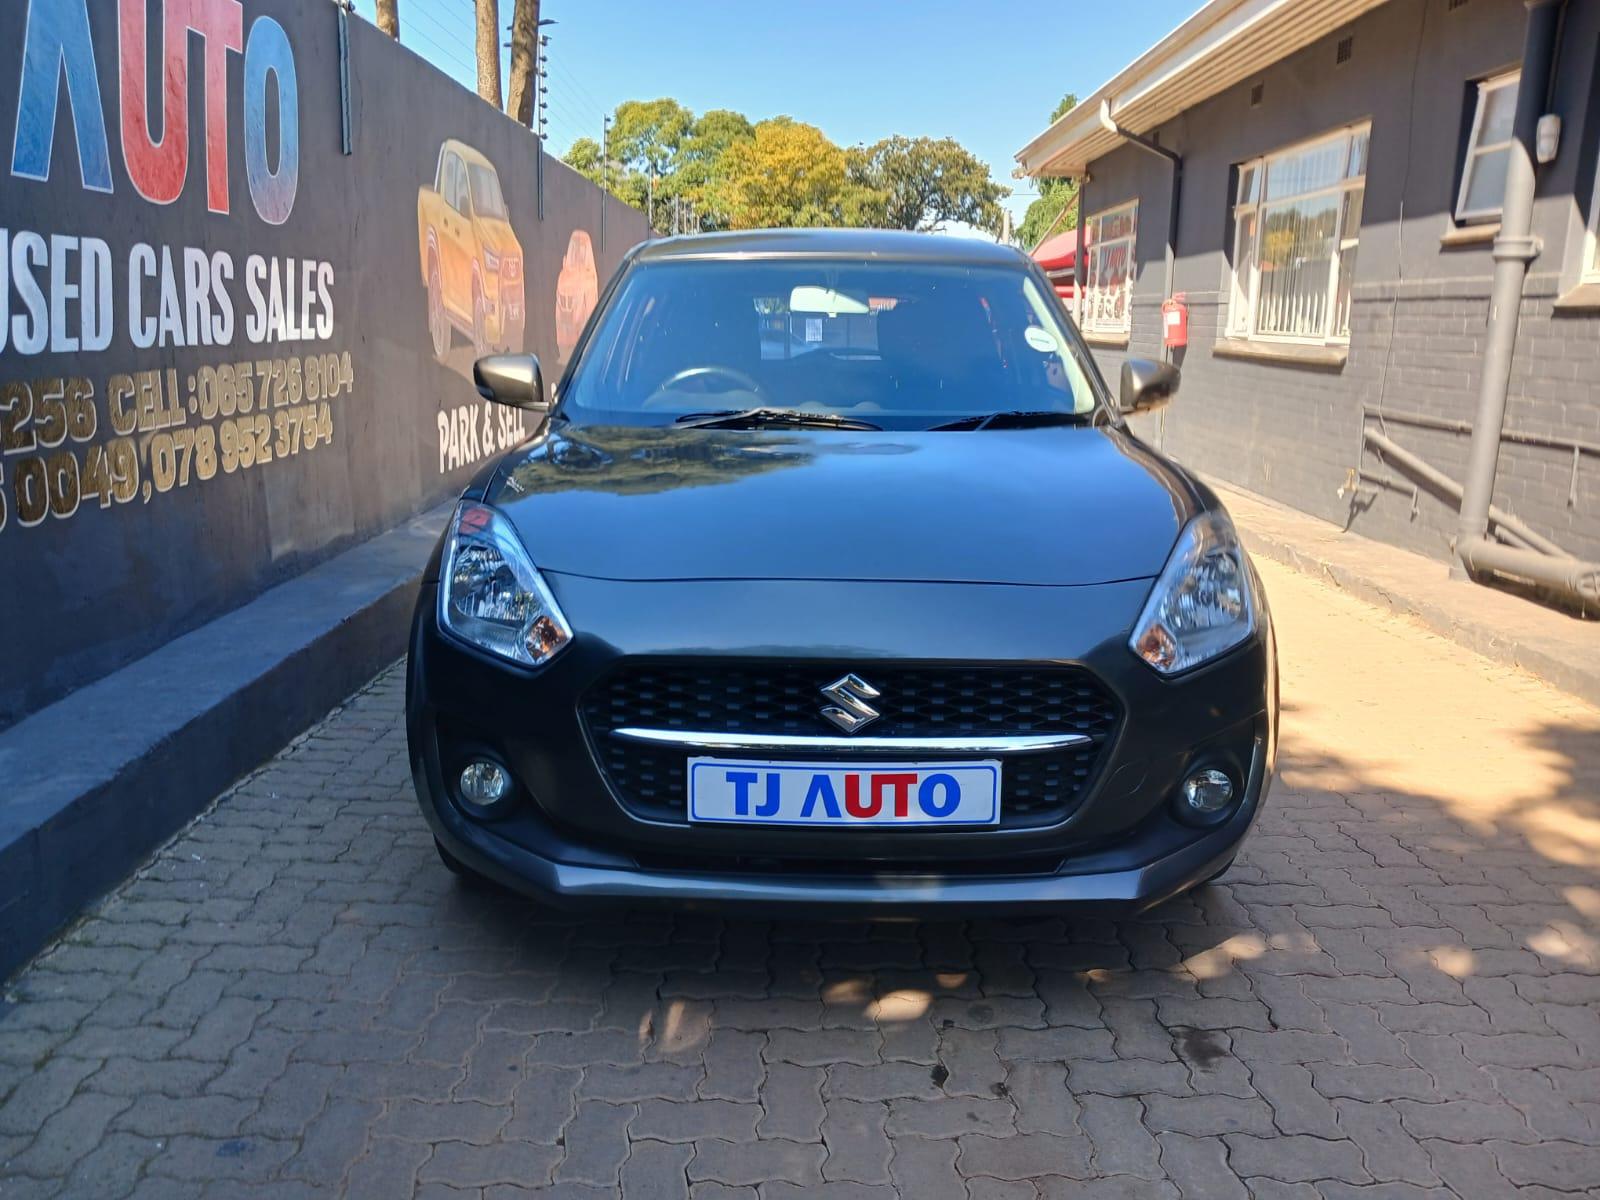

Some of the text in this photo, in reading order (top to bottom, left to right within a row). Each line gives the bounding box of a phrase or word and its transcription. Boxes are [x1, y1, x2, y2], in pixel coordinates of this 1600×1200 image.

[0, 228, 335, 355] SED CARS SALES
[256, 357, 302, 409] 726
[305, 351, 353, 400] 8104
[220, 414, 272, 473] 952
[274, 402, 333, 457] 3754
[437, 401, 525, 474] PARK & SELL
[726, 771, 961, 818] TJ AUTO
